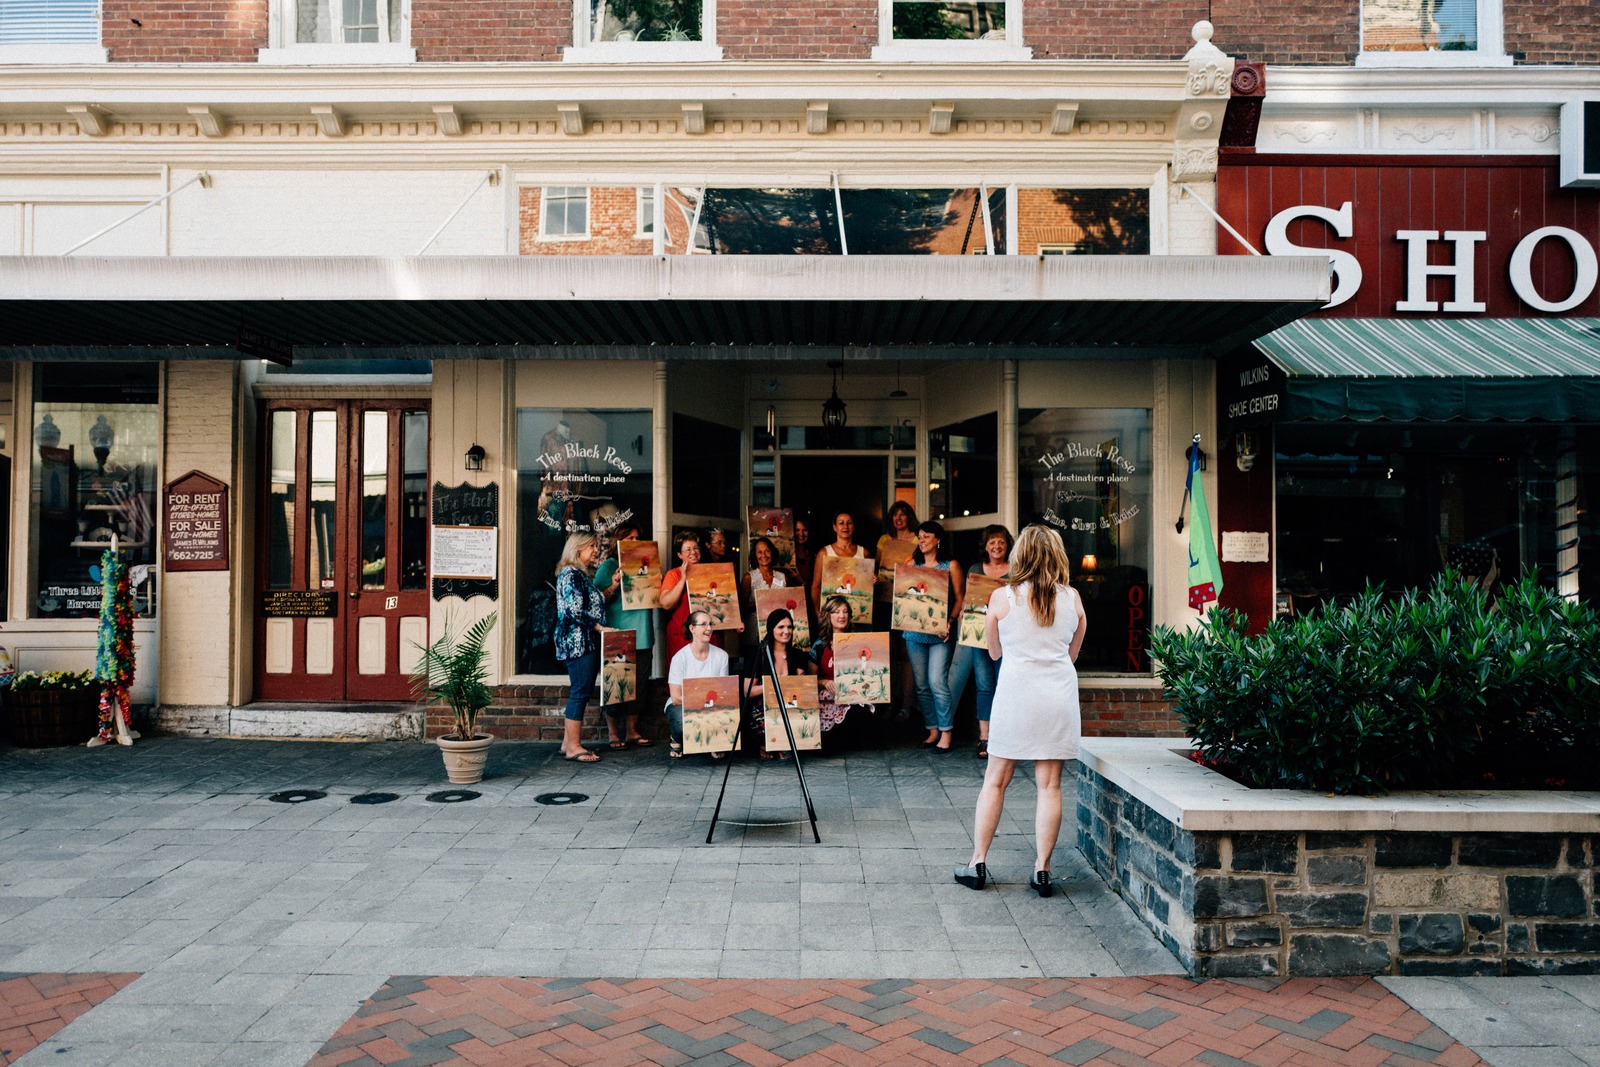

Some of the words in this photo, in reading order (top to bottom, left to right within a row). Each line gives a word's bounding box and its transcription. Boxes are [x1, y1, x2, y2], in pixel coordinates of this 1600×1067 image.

[1240, 365, 1269, 387] WILKINS
[1228, 400, 1248, 418] SHOE
[1249, 394, 1279, 413] CENTER
[535, 451, 562, 469] The
[564, 442, 600, 459] Black
[603, 446, 633, 475] Rose
[1037, 452, 1065, 470] The
[1067, 442, 1103, 458] Black
[1106, 445, 1136, 474] Rose
[540, 472, 551, 481] A
[553, 471, 600, 482] destination
[603, 473, 625, 485] place
[1043, 472, 1054, 481] A
[1056, 471, 1104, 482] destination
[1106, 473, 1129, 484] place
[169, 494, 190, 504] FOR
[194, 493, 221, 503] RENT
[169, 521, 191, 531] FOR
[195, 521, 221, 530] SALE
[1071, 517, 1097, 533] Shop
[1099, 516, 1110, 529] &
[48, 586, 79, 596] Three
[386, 598, 397, 608] 13
[1126, 585, 1144, 672] OPEN
